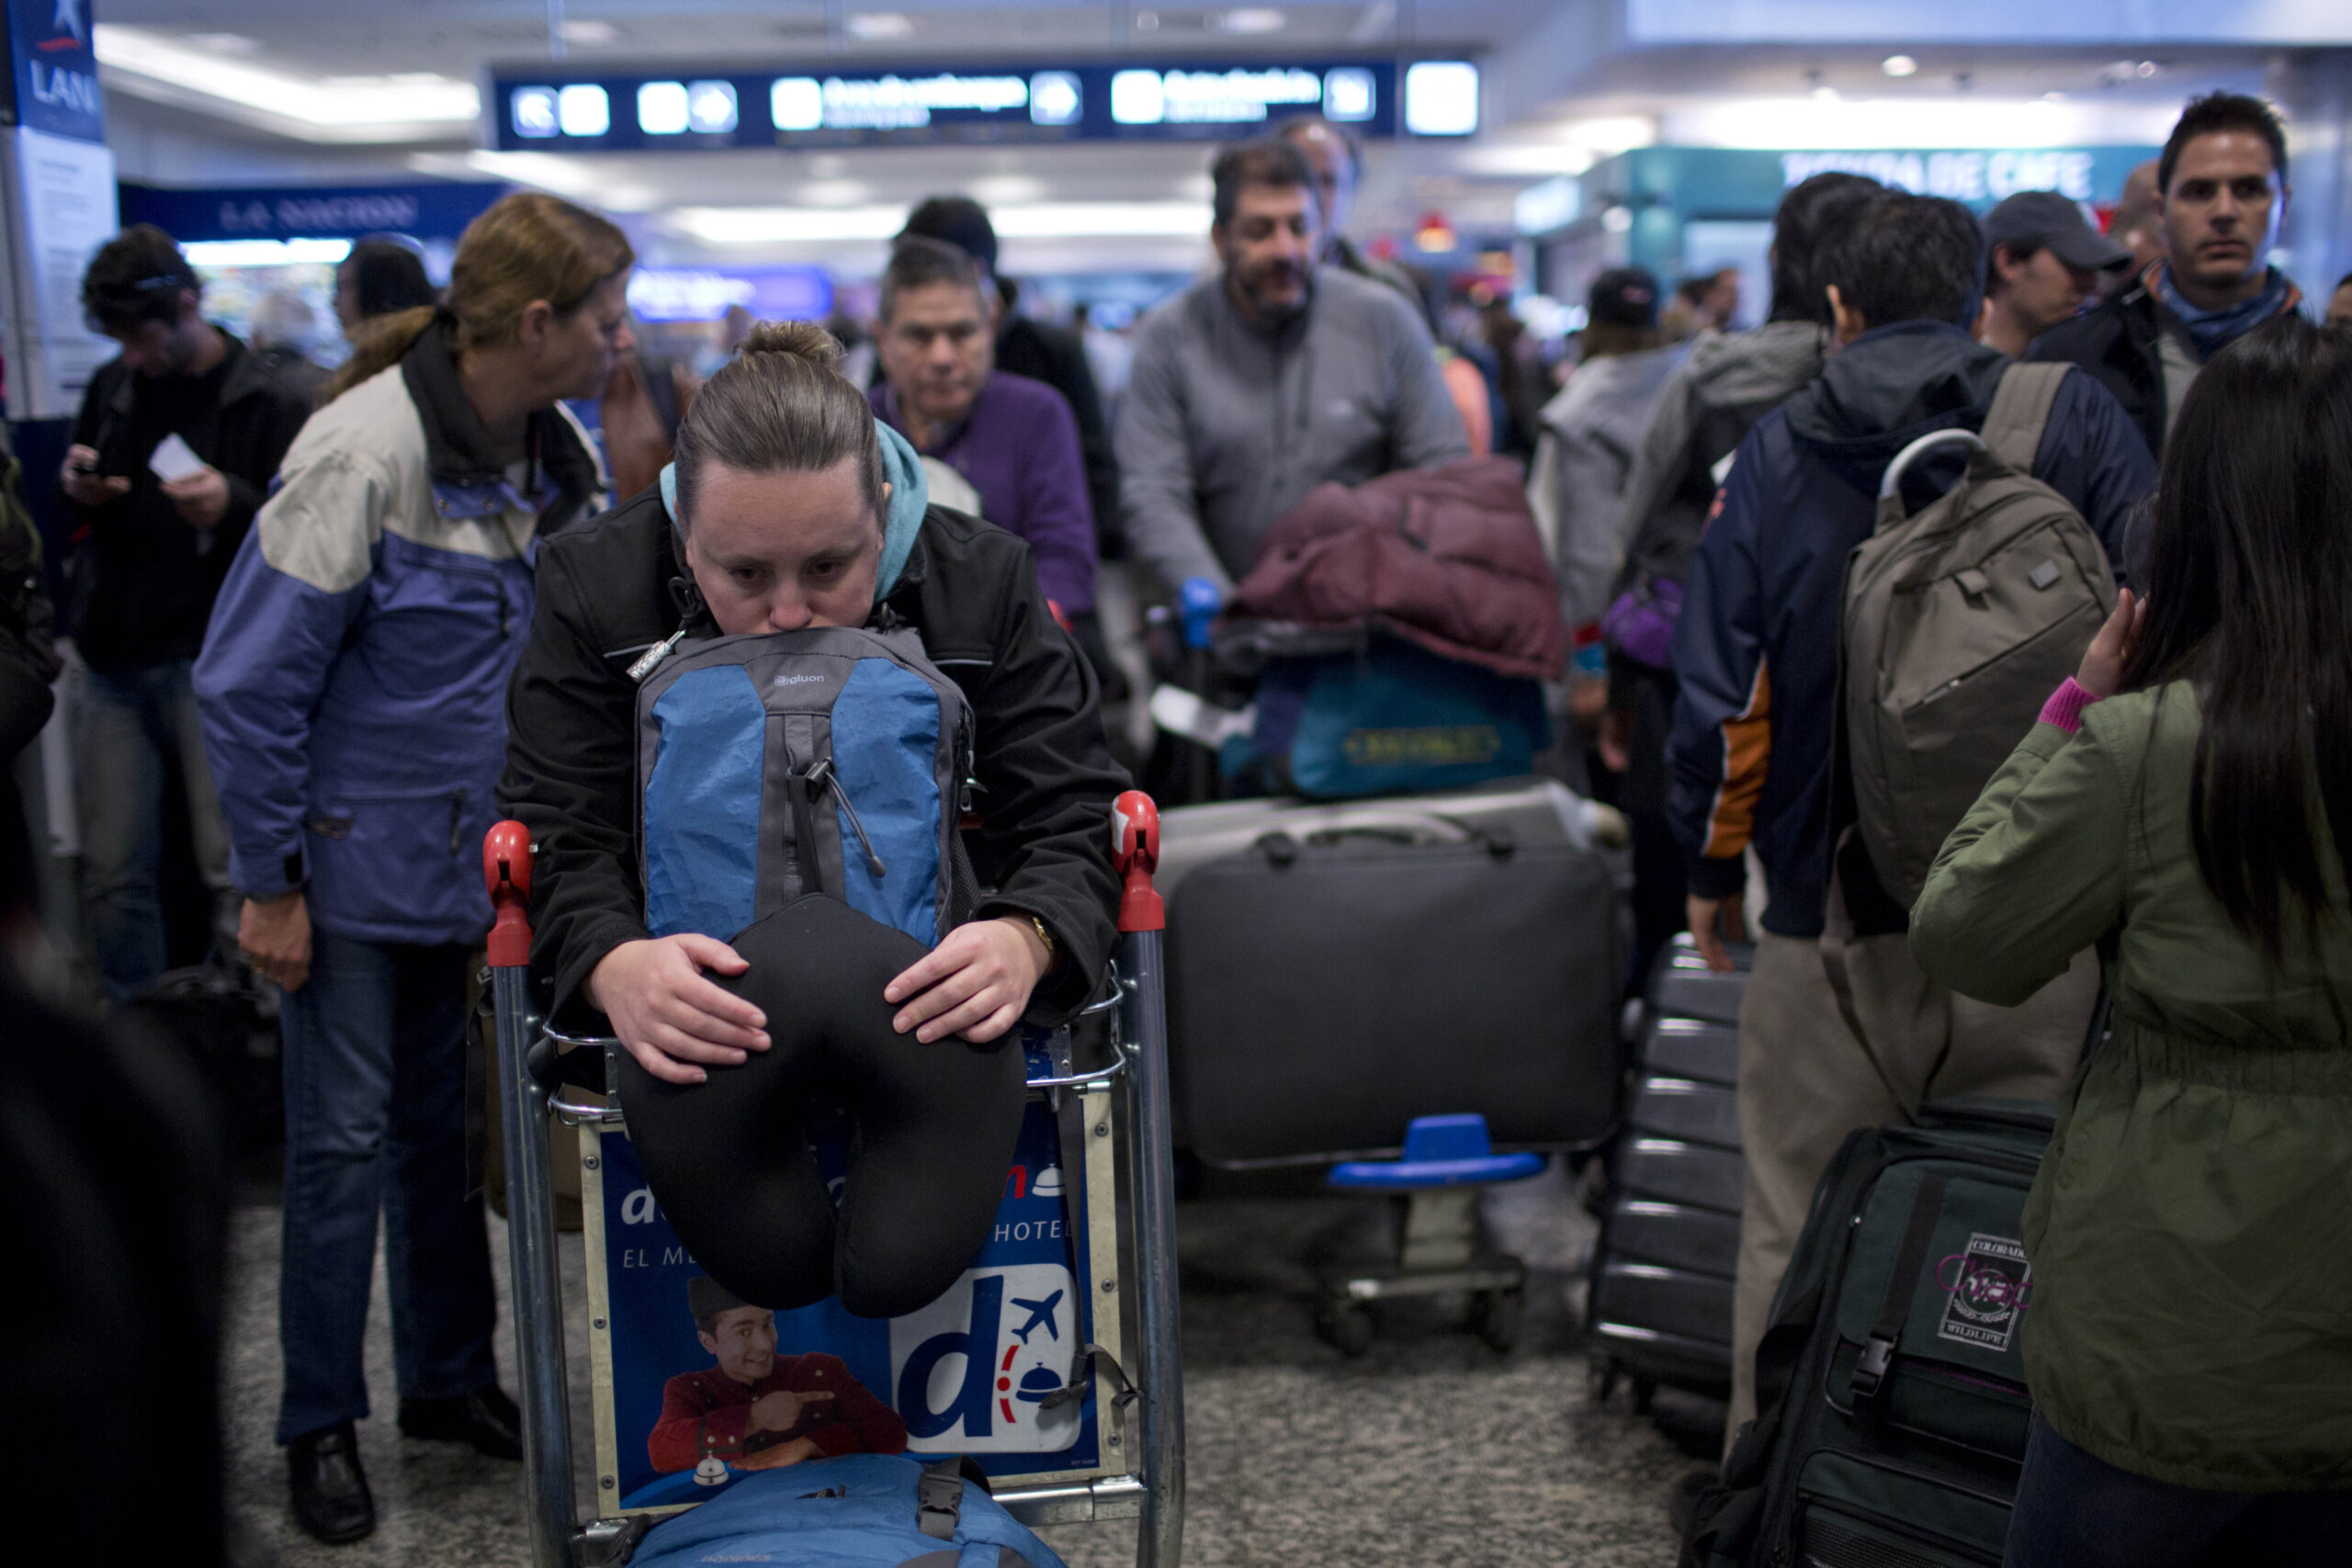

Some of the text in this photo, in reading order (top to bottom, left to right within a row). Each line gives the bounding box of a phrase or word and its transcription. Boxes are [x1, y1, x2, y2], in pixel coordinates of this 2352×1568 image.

[28, 58, 99, 118] LAN
[1928, 152, 1985, 199] DE
[789, 673, 825, 685] gluon
[623, 1248, 650, 1268] EL
[1972, 1239, 2027, 1260] COLORAD
[1947, 1324, 2002, 1344] WILDLIFE
